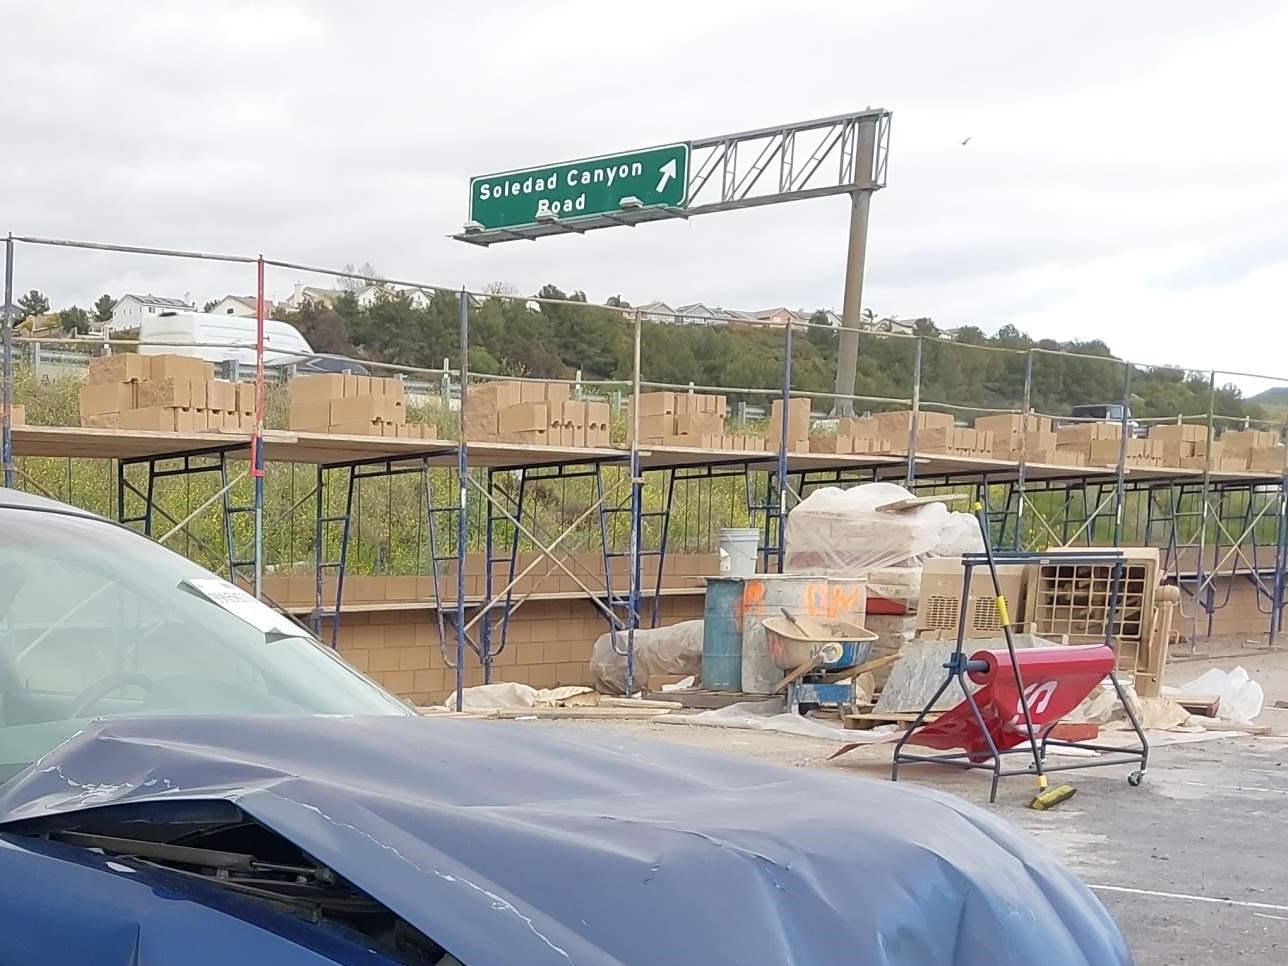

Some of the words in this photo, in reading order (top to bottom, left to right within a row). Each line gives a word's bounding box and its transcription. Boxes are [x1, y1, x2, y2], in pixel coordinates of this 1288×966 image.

[479, 172, 558, 201] Soledad
[567, 162, 643, 188] Canyon
[538, 193, 587, 215] Road
